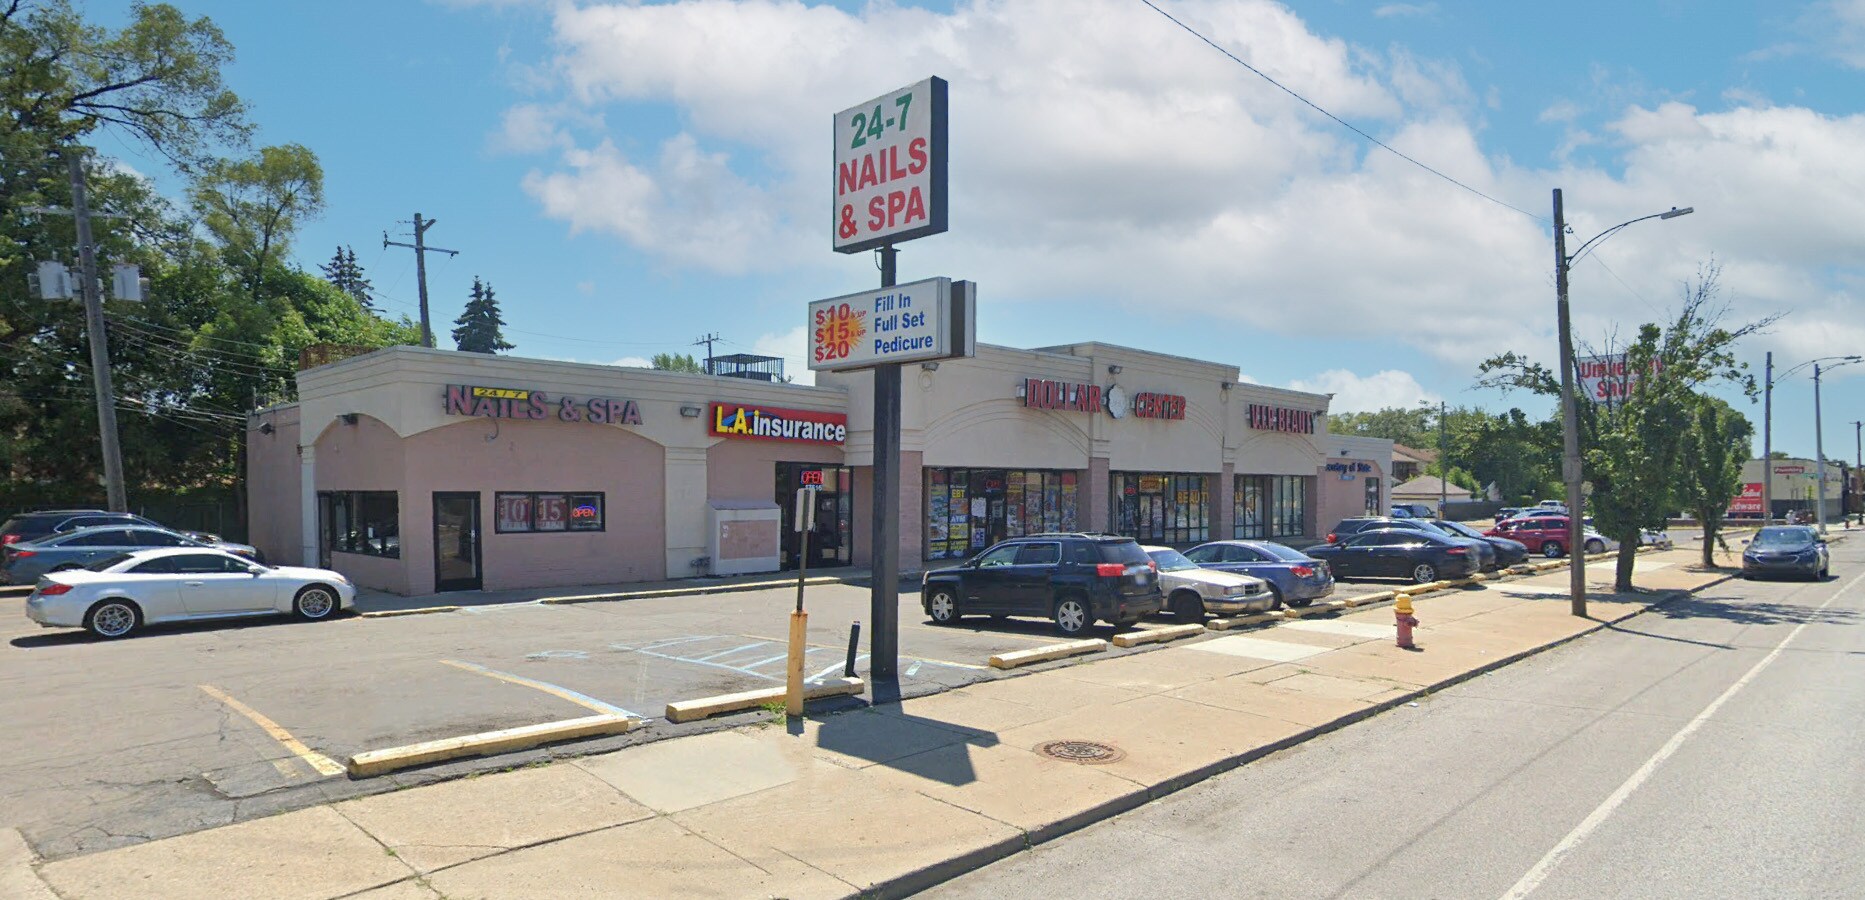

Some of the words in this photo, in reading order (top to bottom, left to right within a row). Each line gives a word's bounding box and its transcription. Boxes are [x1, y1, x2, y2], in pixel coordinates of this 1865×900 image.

[851, 92, 913, 149] 24-7
[839, 137, 927, 196] NAILS
[838, 204, 858, 240] &
[868, 186, 926, 232] SPA
[815, 303, 851, 325] $10
[875, 295, 894, 313] Fill
[898, 293, 911, 309] In
[815, 321, 850, 344] $15
[874, 314, 898, 333] Full
[902, 310, 925, 329] Set
[814, 340, 850, 364] $20
[874, 335, 934, 355] Pedicure
[446, 384, 549, 420] NAILS
[558, 395, 581, 423] &
[587, 397, 644, 426] SPA
[1025, 378, 1101, 413] DOLLAR
[1135, 392, 1187, 420] CENTER
[1277, 407, 1316, 434] BEAUTY
[801, 470, 823, 485] OPEN
[952, 489, 966, 498] EBT
[571, 507, 595, 518] OPEN
